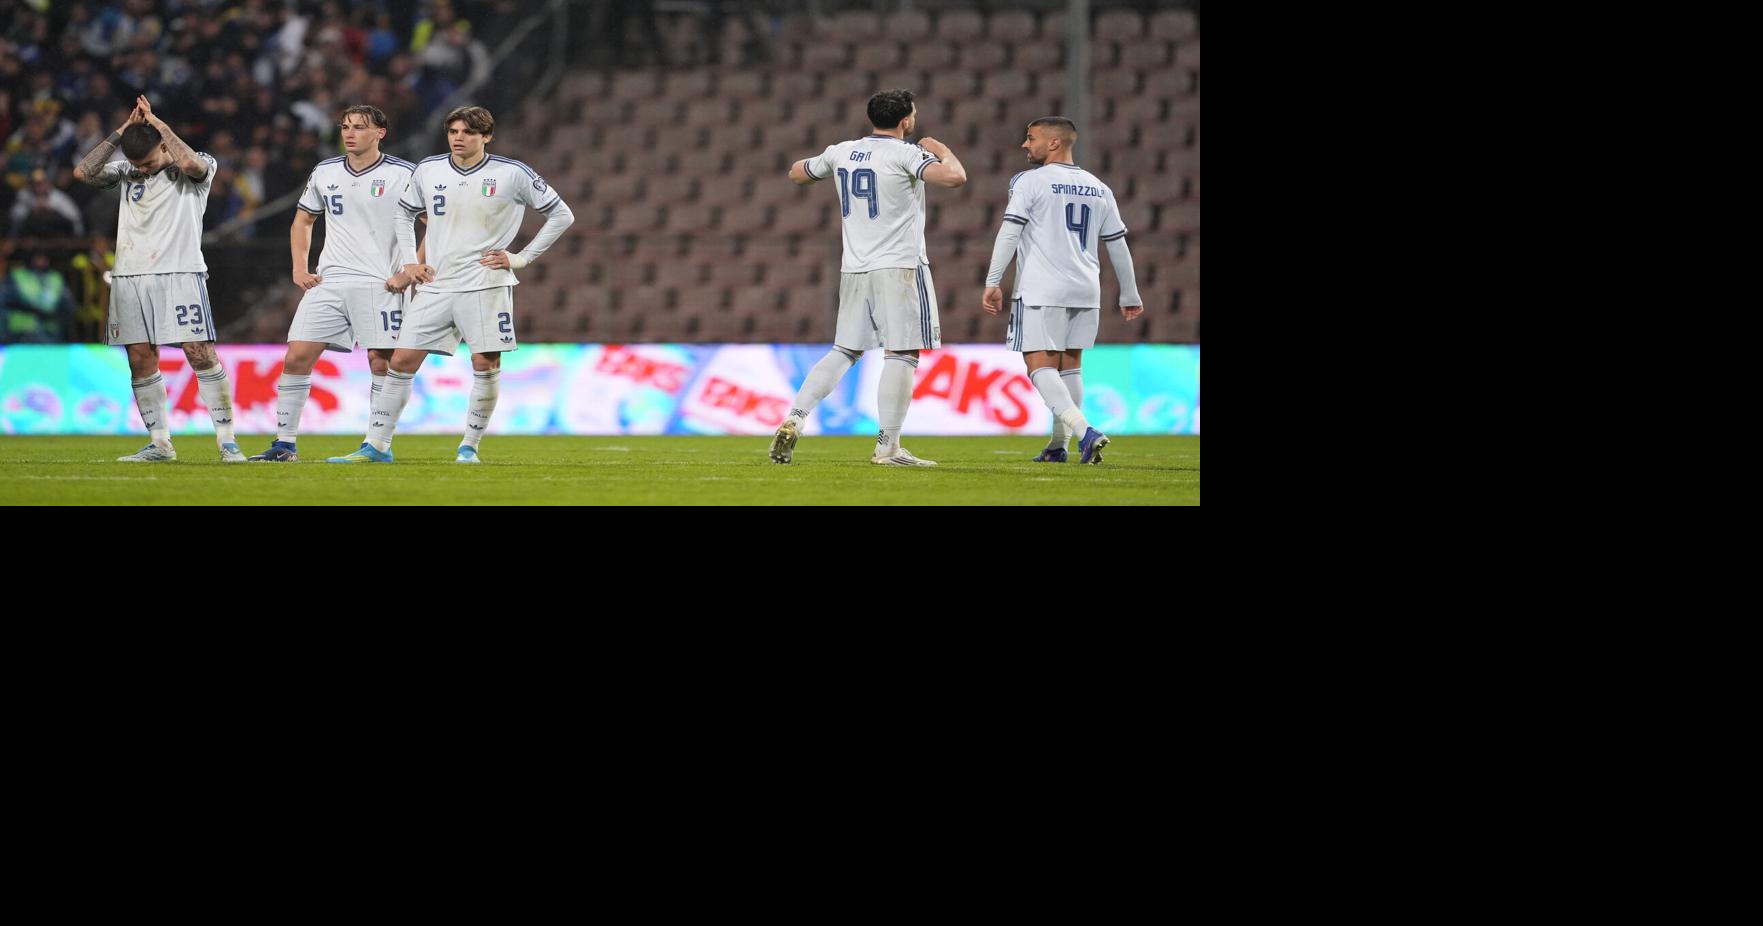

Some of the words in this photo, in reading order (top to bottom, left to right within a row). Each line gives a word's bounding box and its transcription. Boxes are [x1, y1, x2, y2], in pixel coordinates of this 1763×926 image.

[837, 167, 880, 219] 19
[322, 194, 344, 215] 15
[433, 194, 446, 216] 2
[1065, 202, 1091, 252] 4
[175, 304, 203, 326] 23
[380, 310, 403, 331] 15
[497, 312, 512, 333] 2
[912, 349, 1033, 428] AKS
